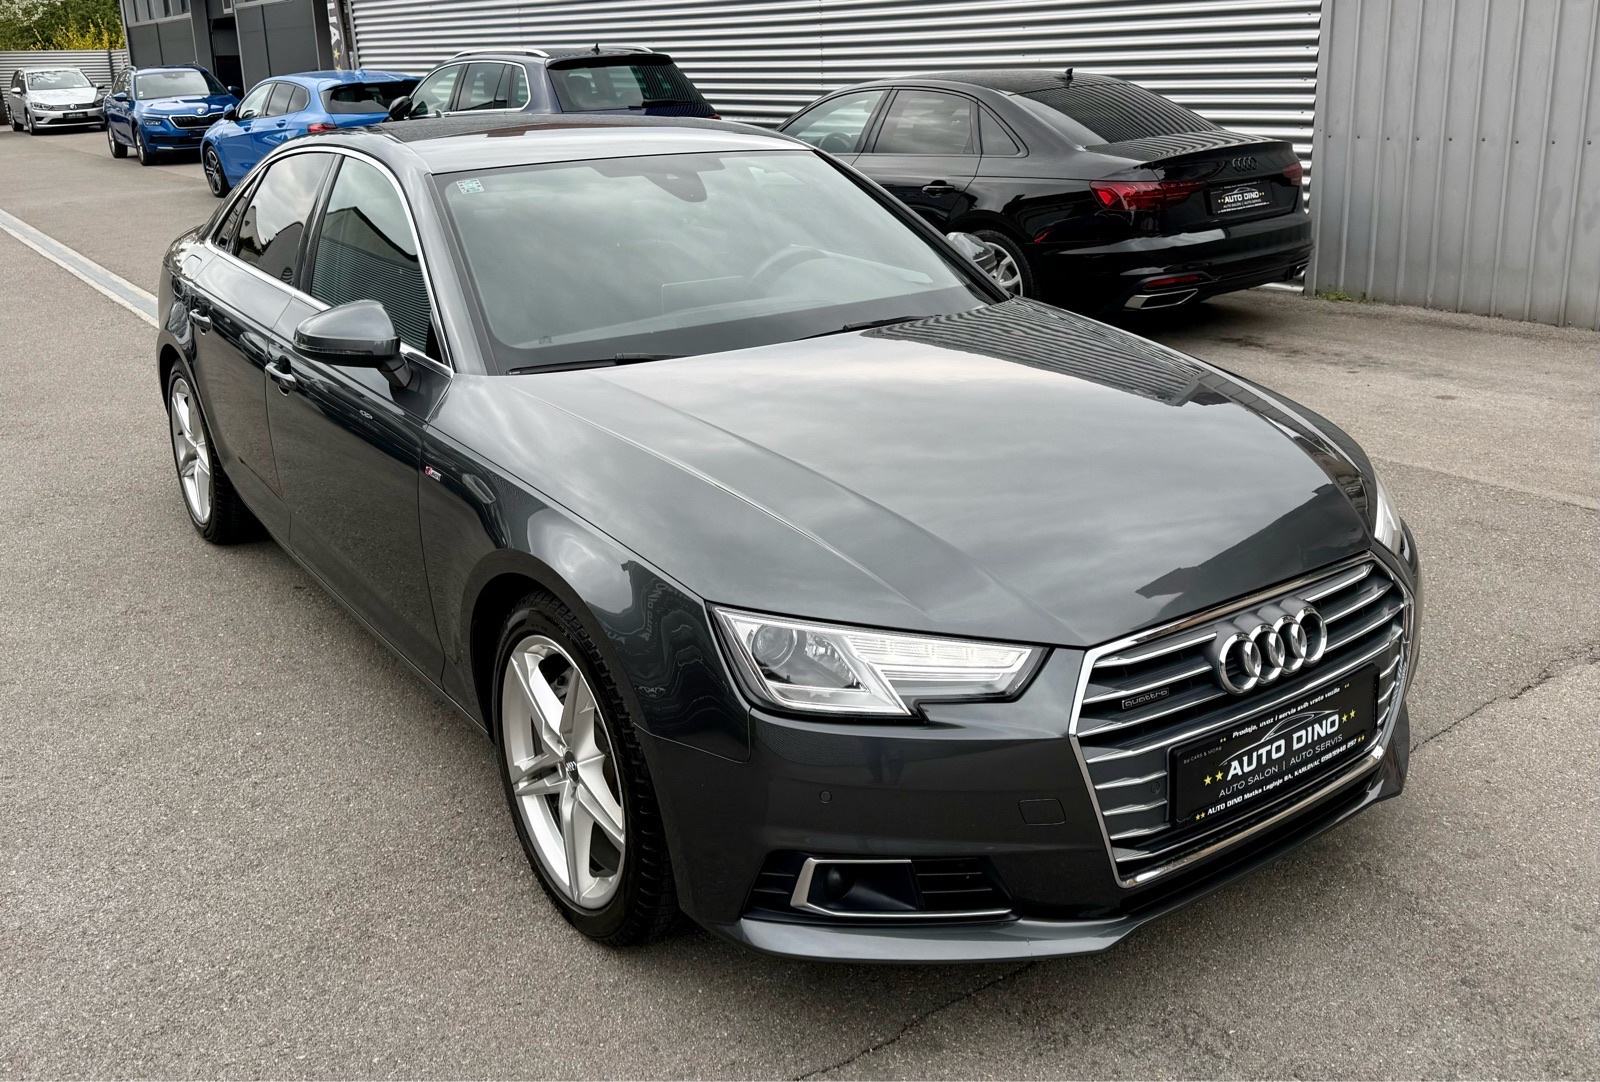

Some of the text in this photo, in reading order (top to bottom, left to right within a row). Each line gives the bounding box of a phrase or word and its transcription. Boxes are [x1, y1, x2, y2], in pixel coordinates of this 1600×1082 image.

[1224, 192, 1259, 203] AUTO DINO
[1124, 690, 1168, 707] quattro
[1226, 714, 1340, 780] AUTO DINO
[1289, 734, 1343, 766] AUTO SERVIS
[1218, 765, 1279, 798] AUTO SALON
[1208, 803, 1226, 815] AUTO
[1227, 796, 1243, 807] DINO
